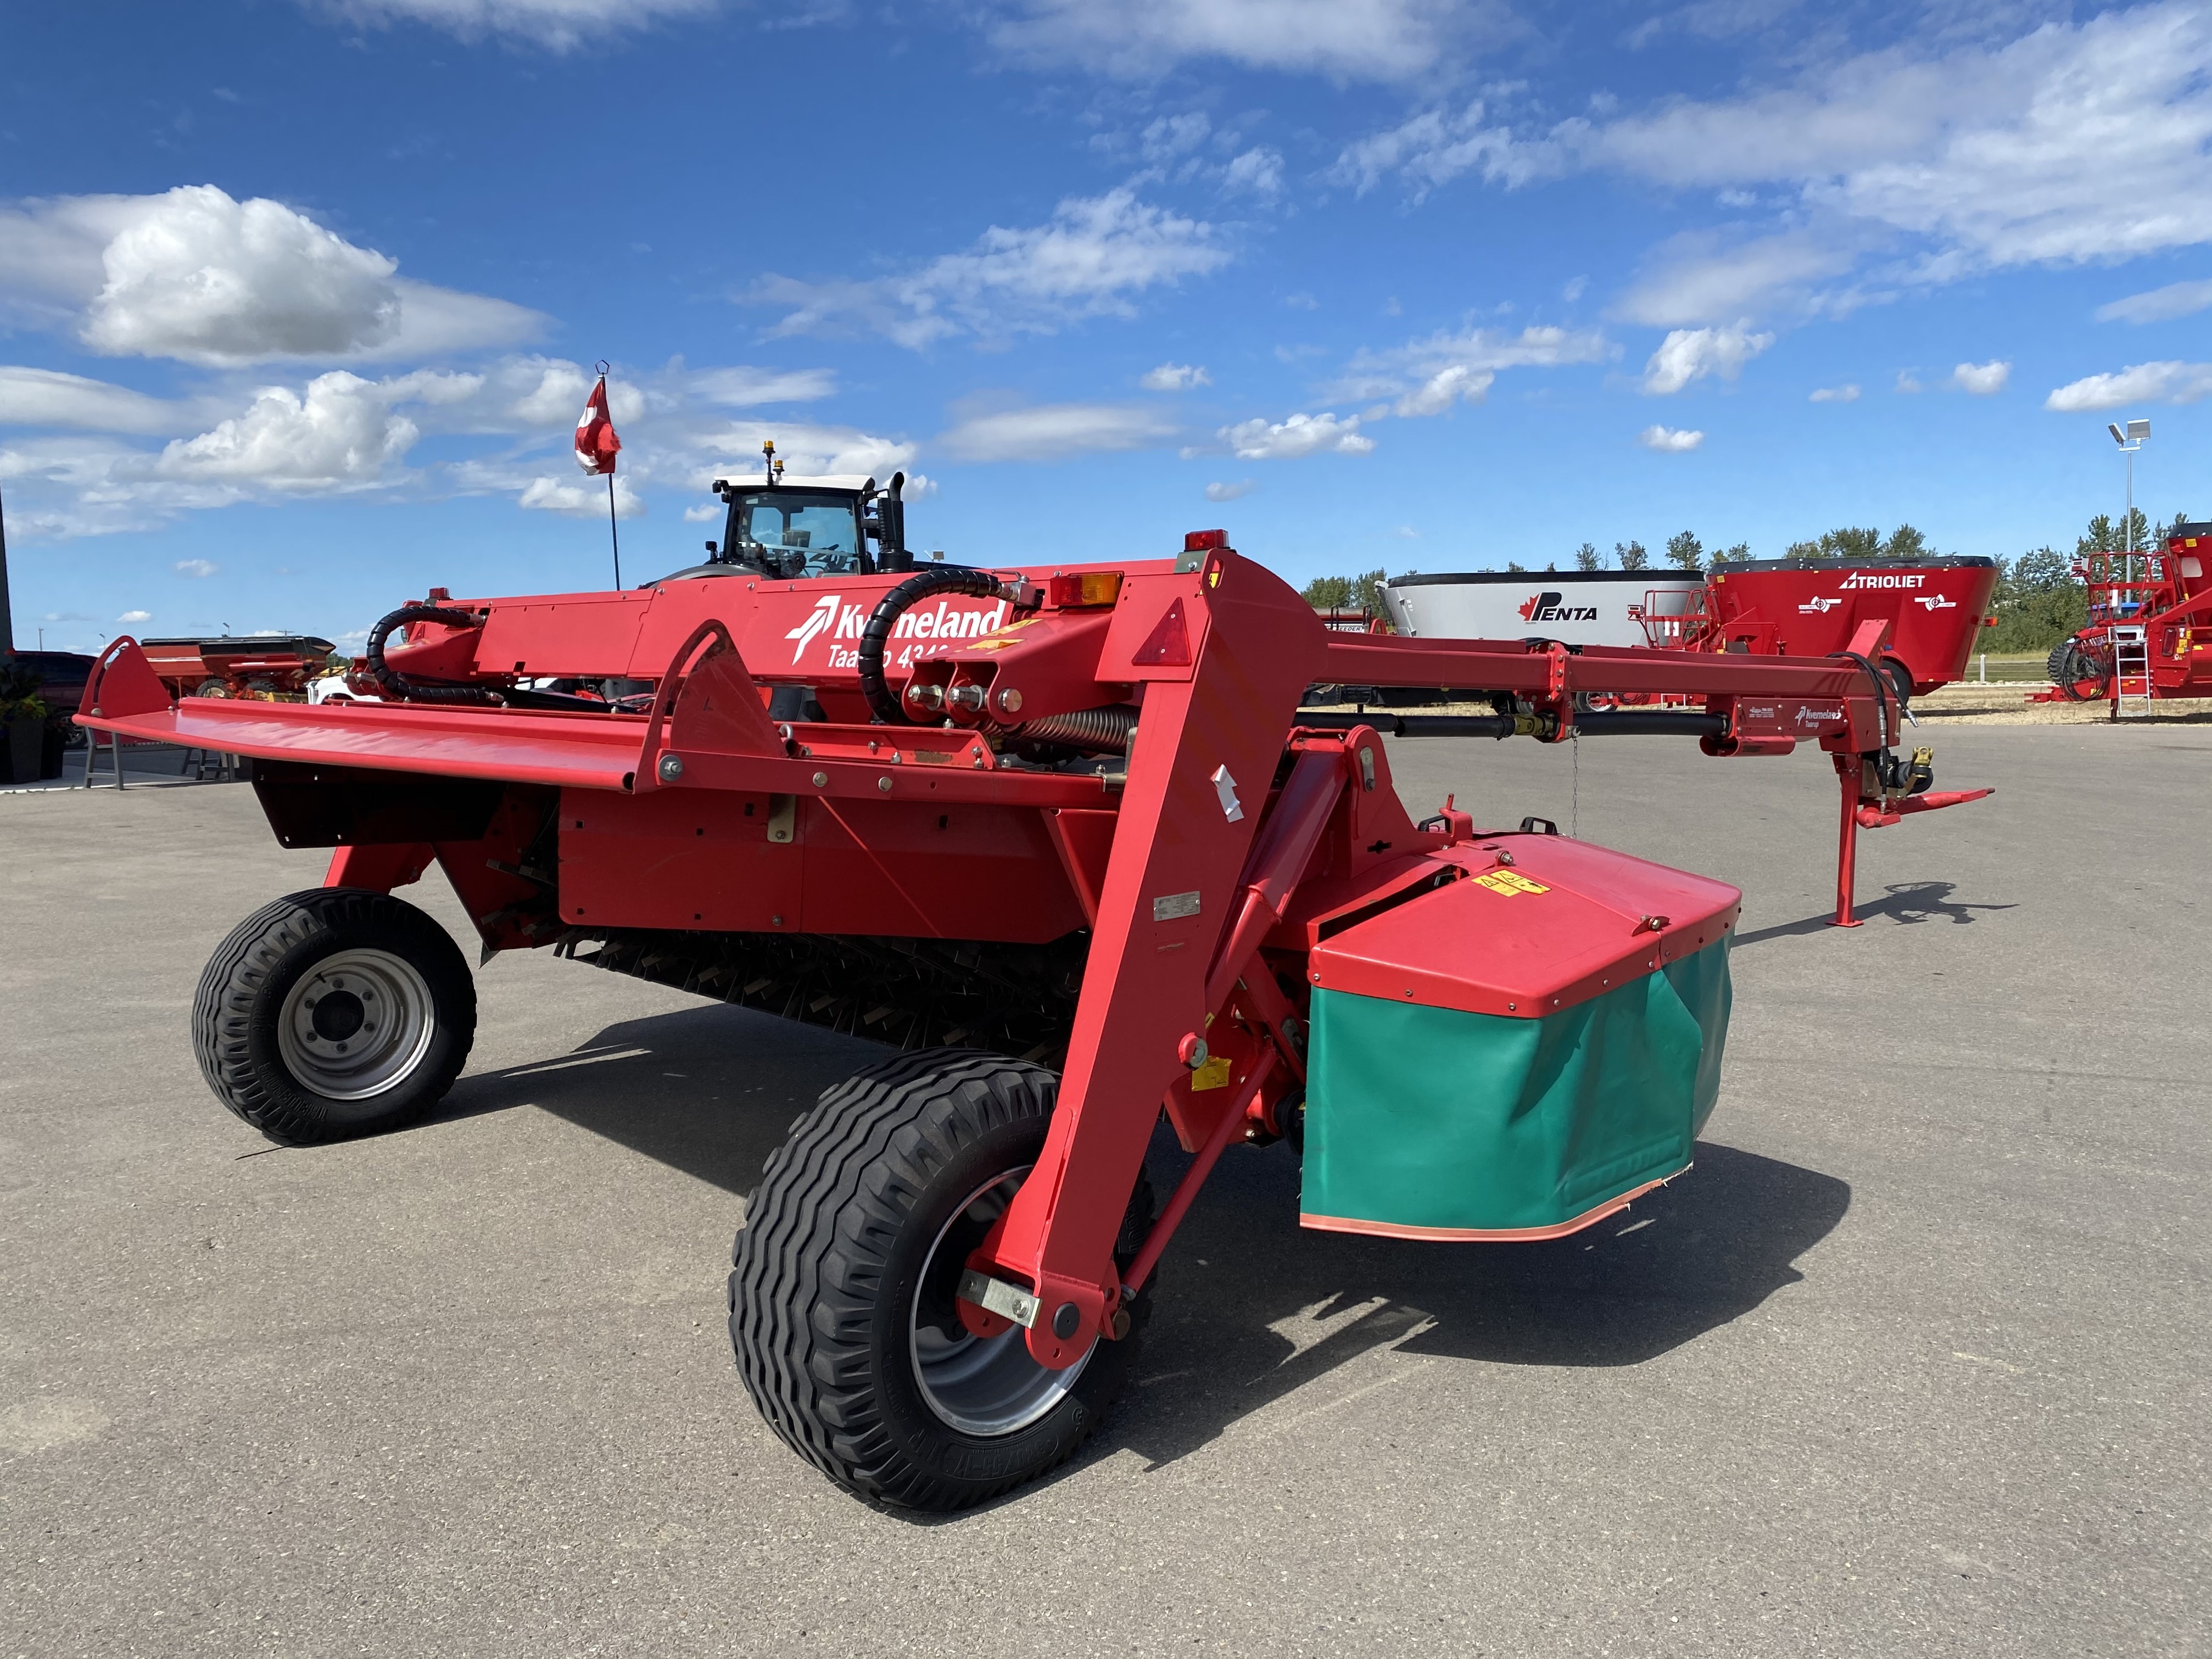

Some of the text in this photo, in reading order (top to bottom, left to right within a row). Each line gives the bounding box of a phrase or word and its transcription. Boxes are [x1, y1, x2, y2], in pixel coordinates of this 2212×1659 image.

[1857, 576, 1925, 589] TRIOLIET
[834, 599, 1007, 639] Kvneland
[1531, 593, 1597, 621] PENTA
